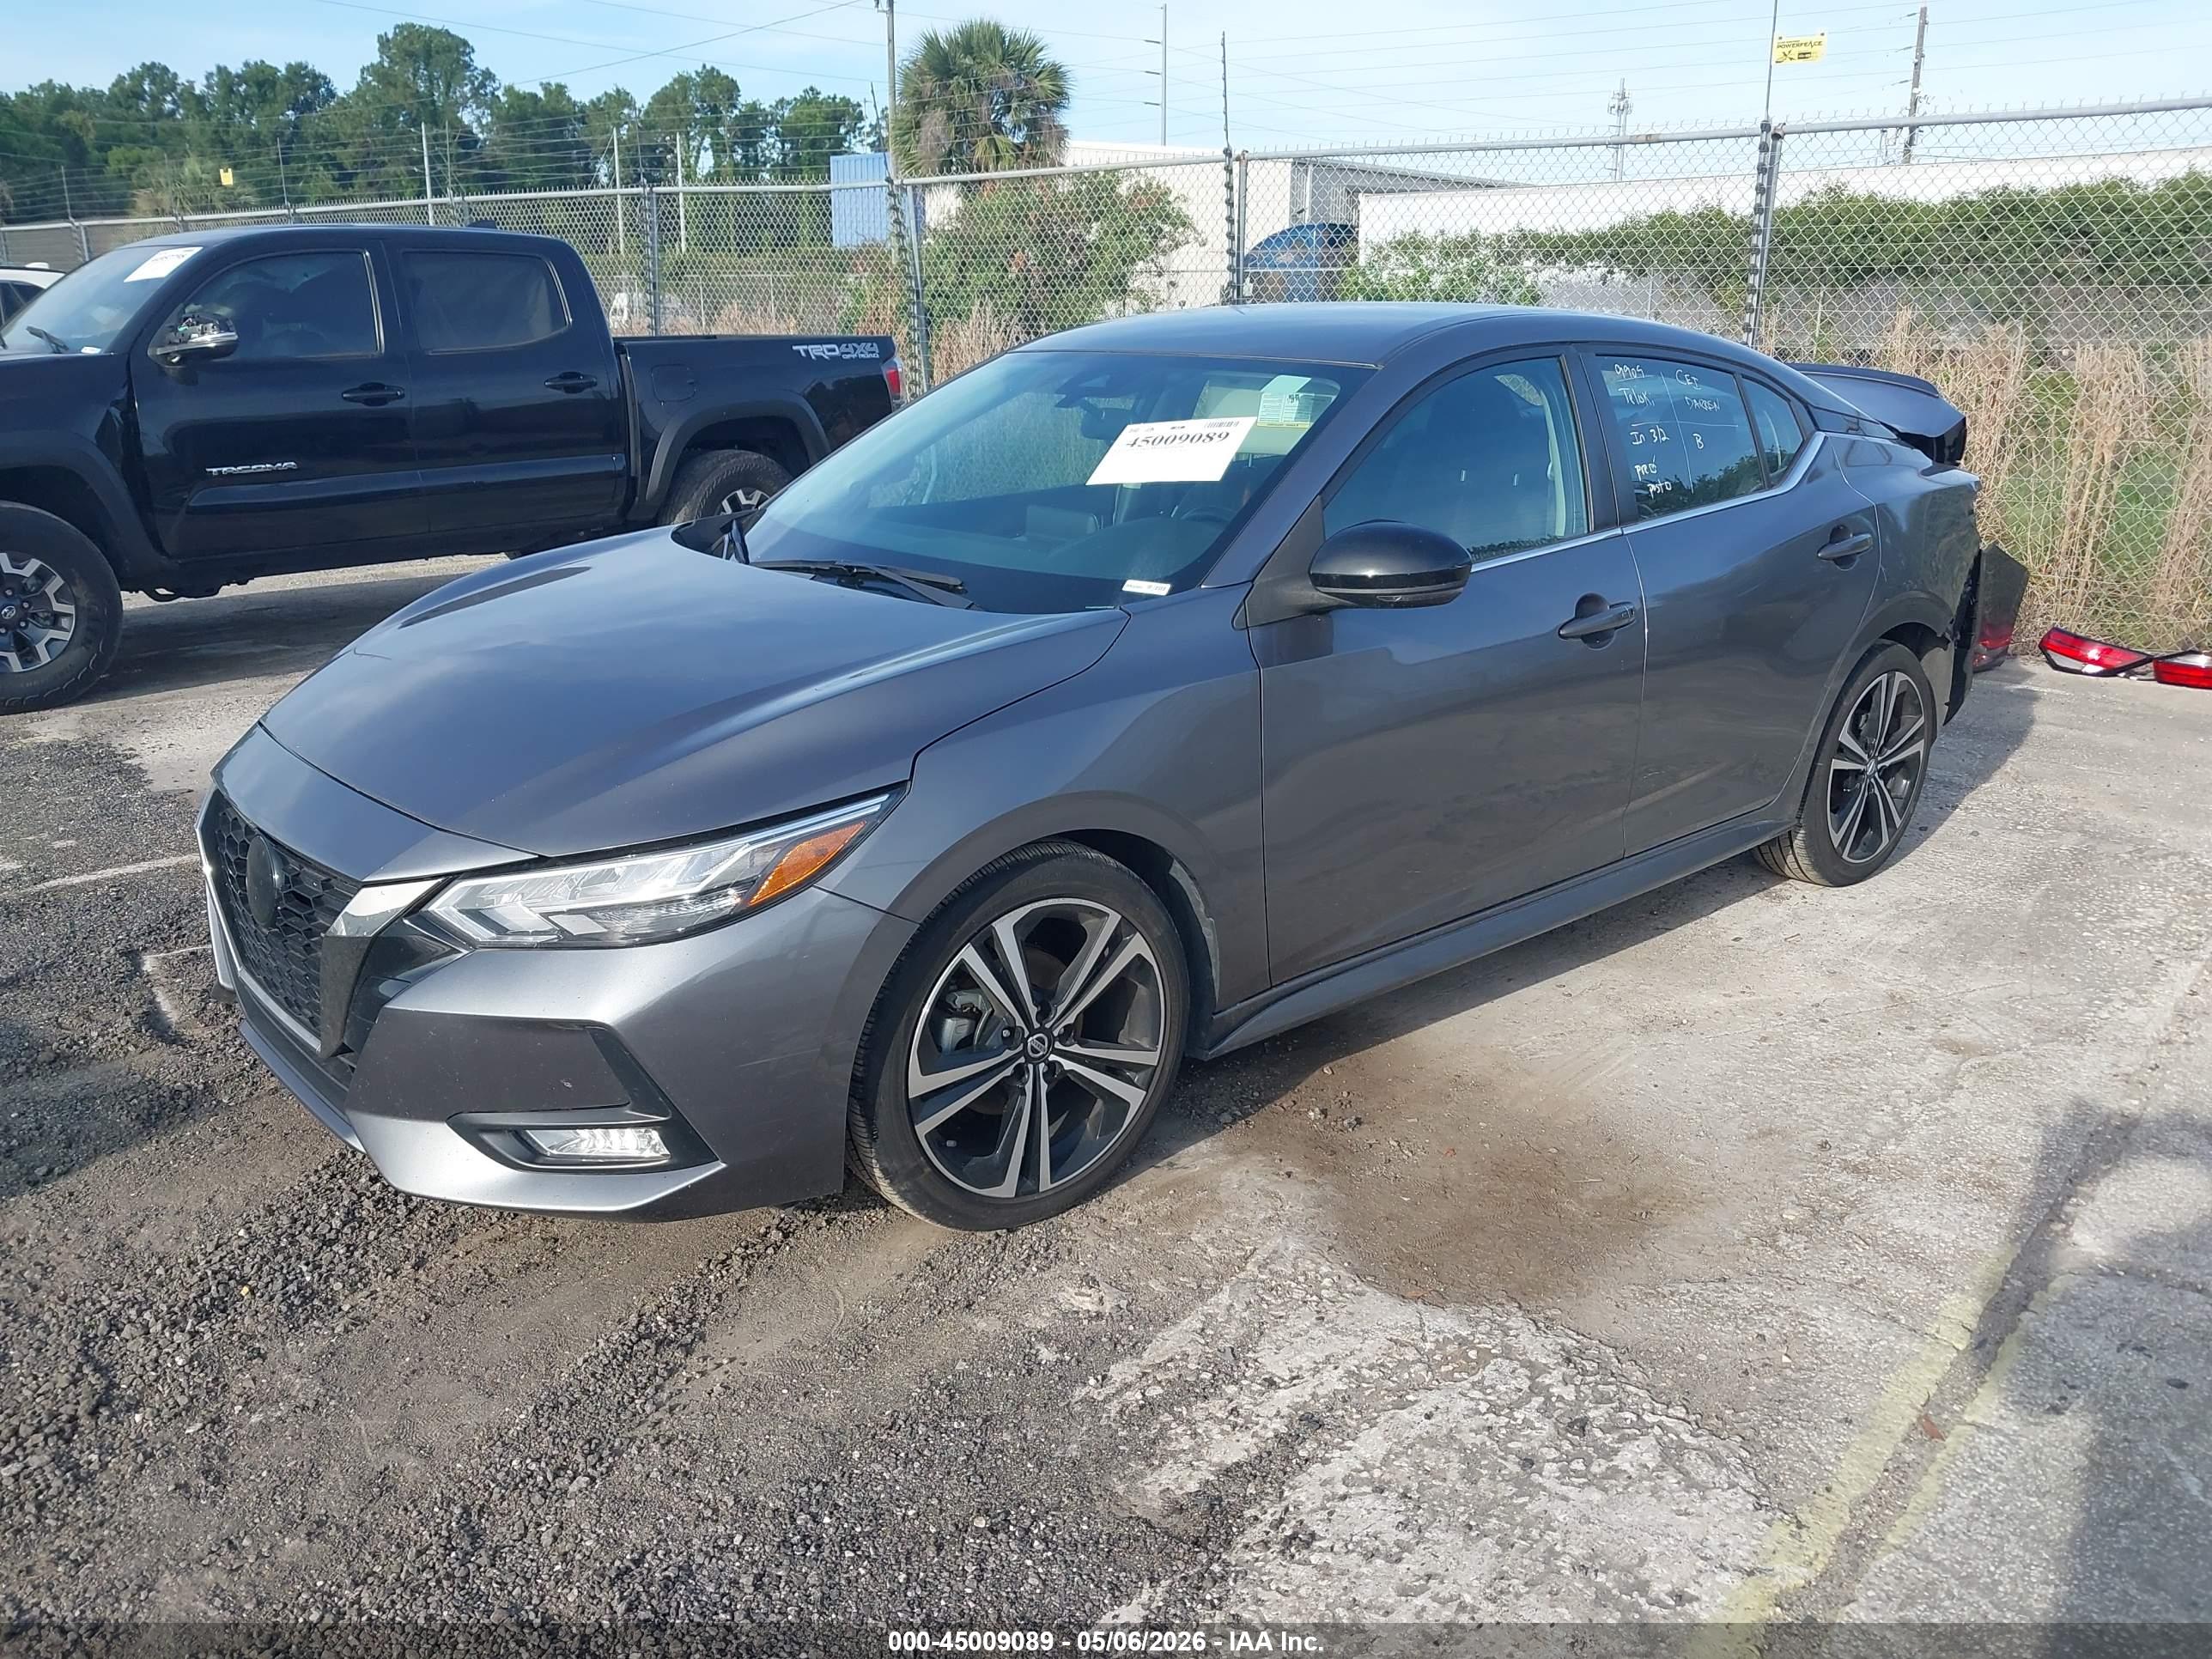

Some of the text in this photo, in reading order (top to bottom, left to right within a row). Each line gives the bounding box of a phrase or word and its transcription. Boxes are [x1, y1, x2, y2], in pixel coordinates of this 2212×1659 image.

[792, 343, 841, 360] TRD
[1127, 431, 1230, 447] 45009089
[1692, 433, 1704, 449] B
